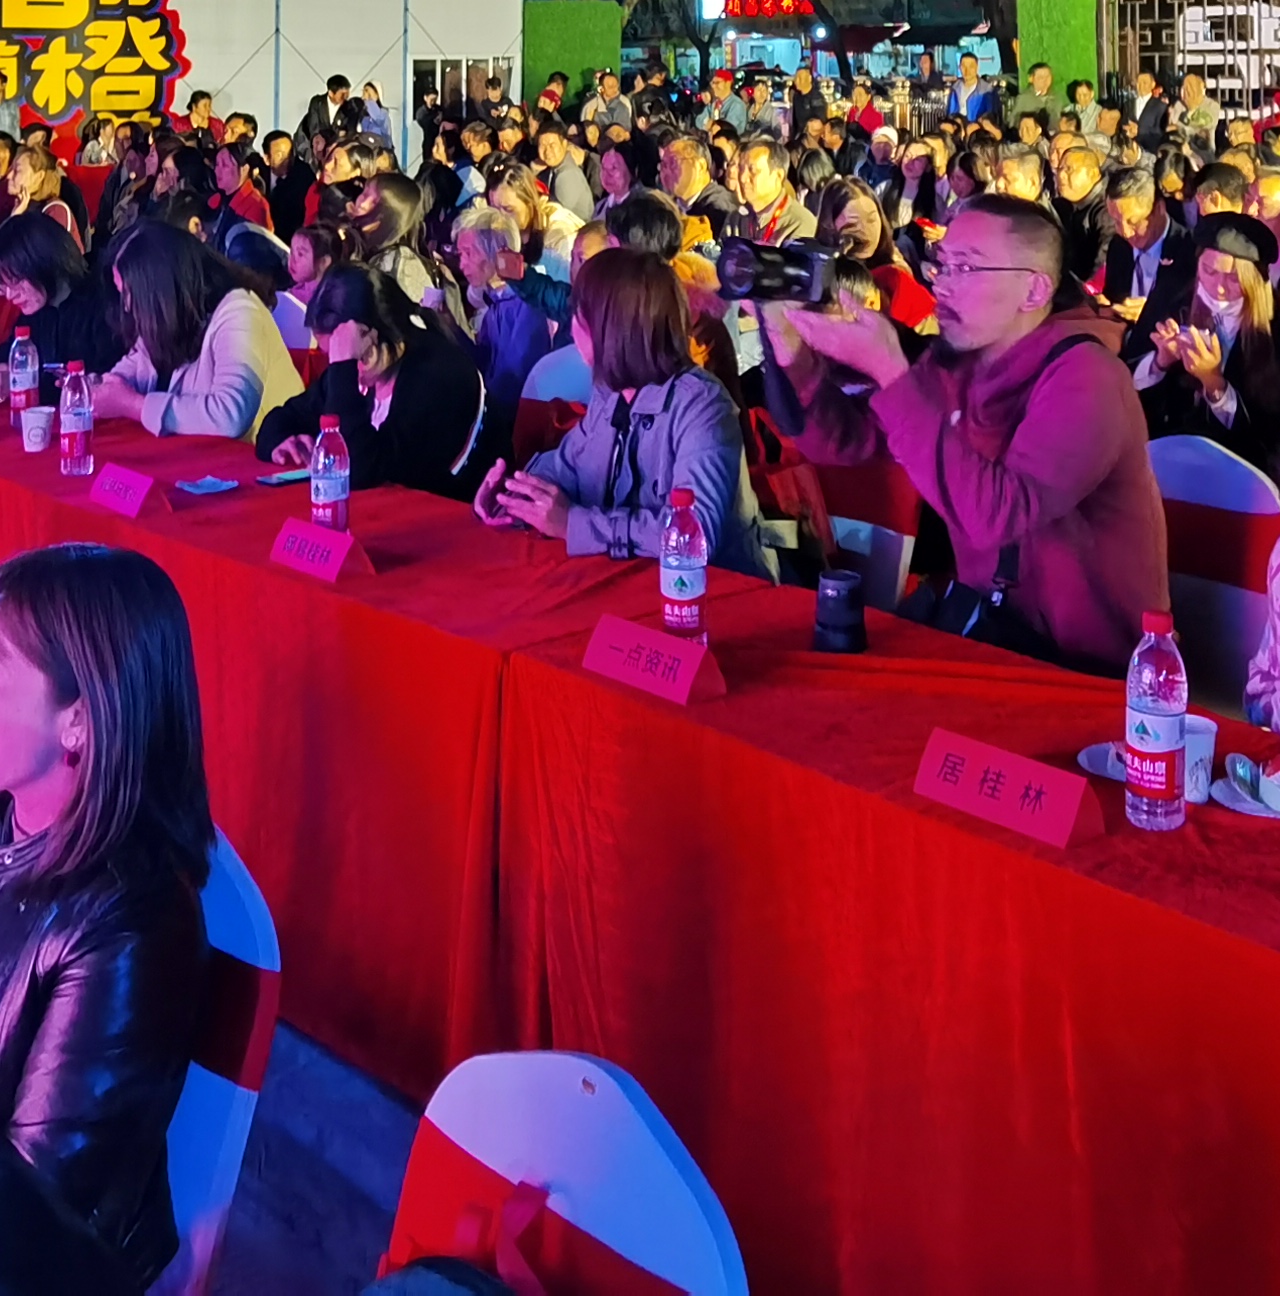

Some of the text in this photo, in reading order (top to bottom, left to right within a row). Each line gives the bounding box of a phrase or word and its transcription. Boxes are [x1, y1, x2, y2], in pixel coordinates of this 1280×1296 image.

[608, 640, 681, 684] 一点资讯
[936, 751, 1049, 816] 居桂林
